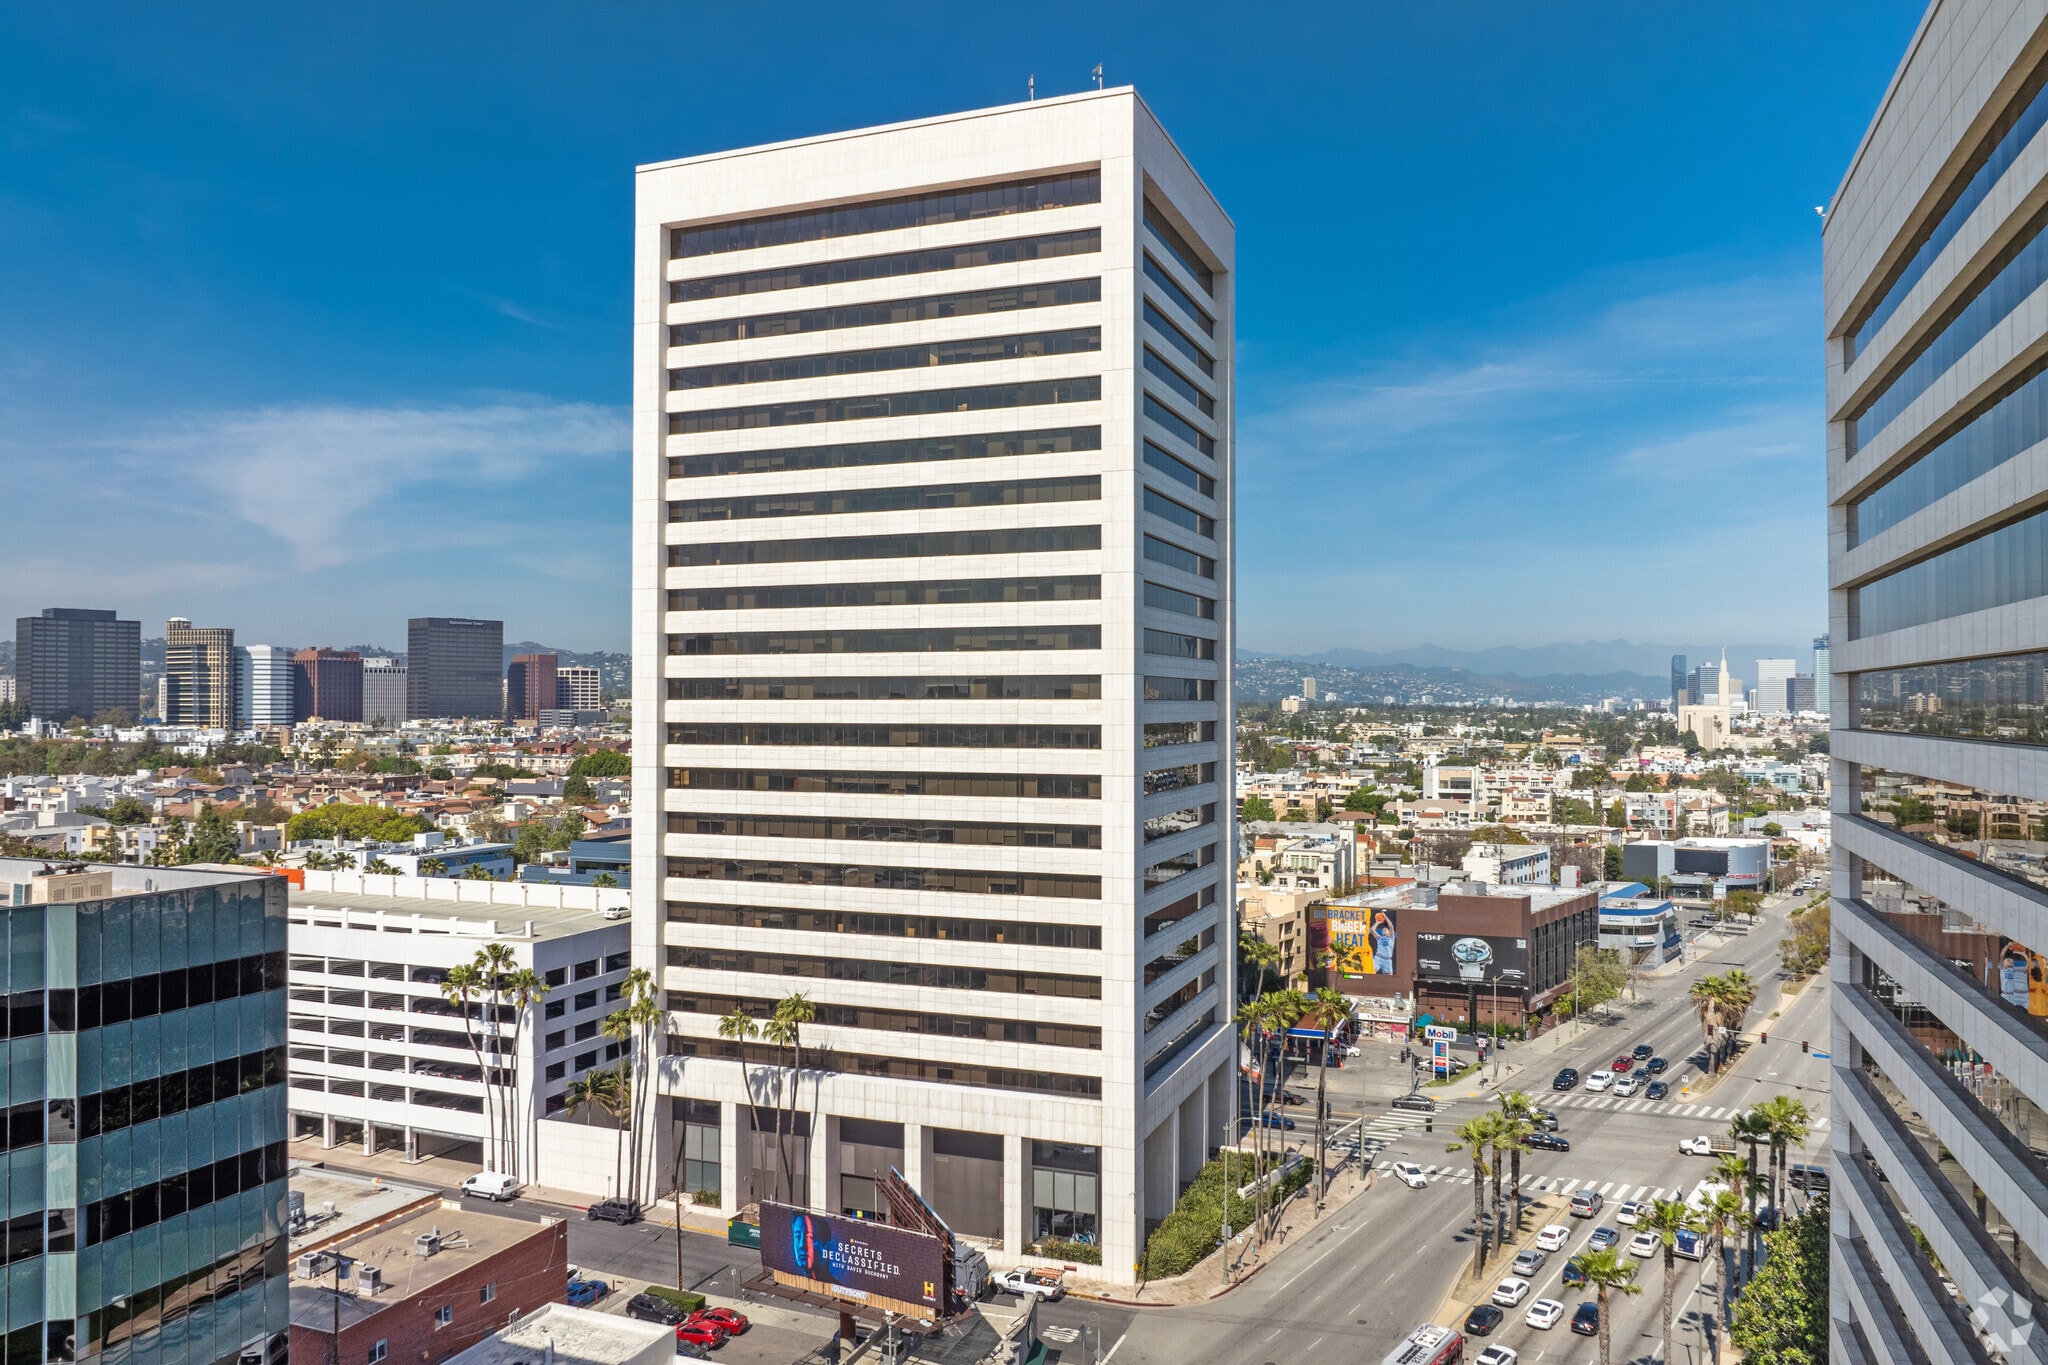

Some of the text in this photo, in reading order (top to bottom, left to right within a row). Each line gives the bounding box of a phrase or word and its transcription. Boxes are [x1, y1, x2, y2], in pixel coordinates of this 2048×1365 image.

[1313, 909, 1366, 920] BIG BRACKET
[1331, 920, 1366, 933] BIGGER
[1336, 932, 1364, 947] HEAT
[1427, 1028, 1454, 1040] Mobil
[838, 1242, 882, 1261] SECRETS
[847, 1265, 862, 1274] DAVID
[864, 1269, 889, 1280] DUCHOVNY
